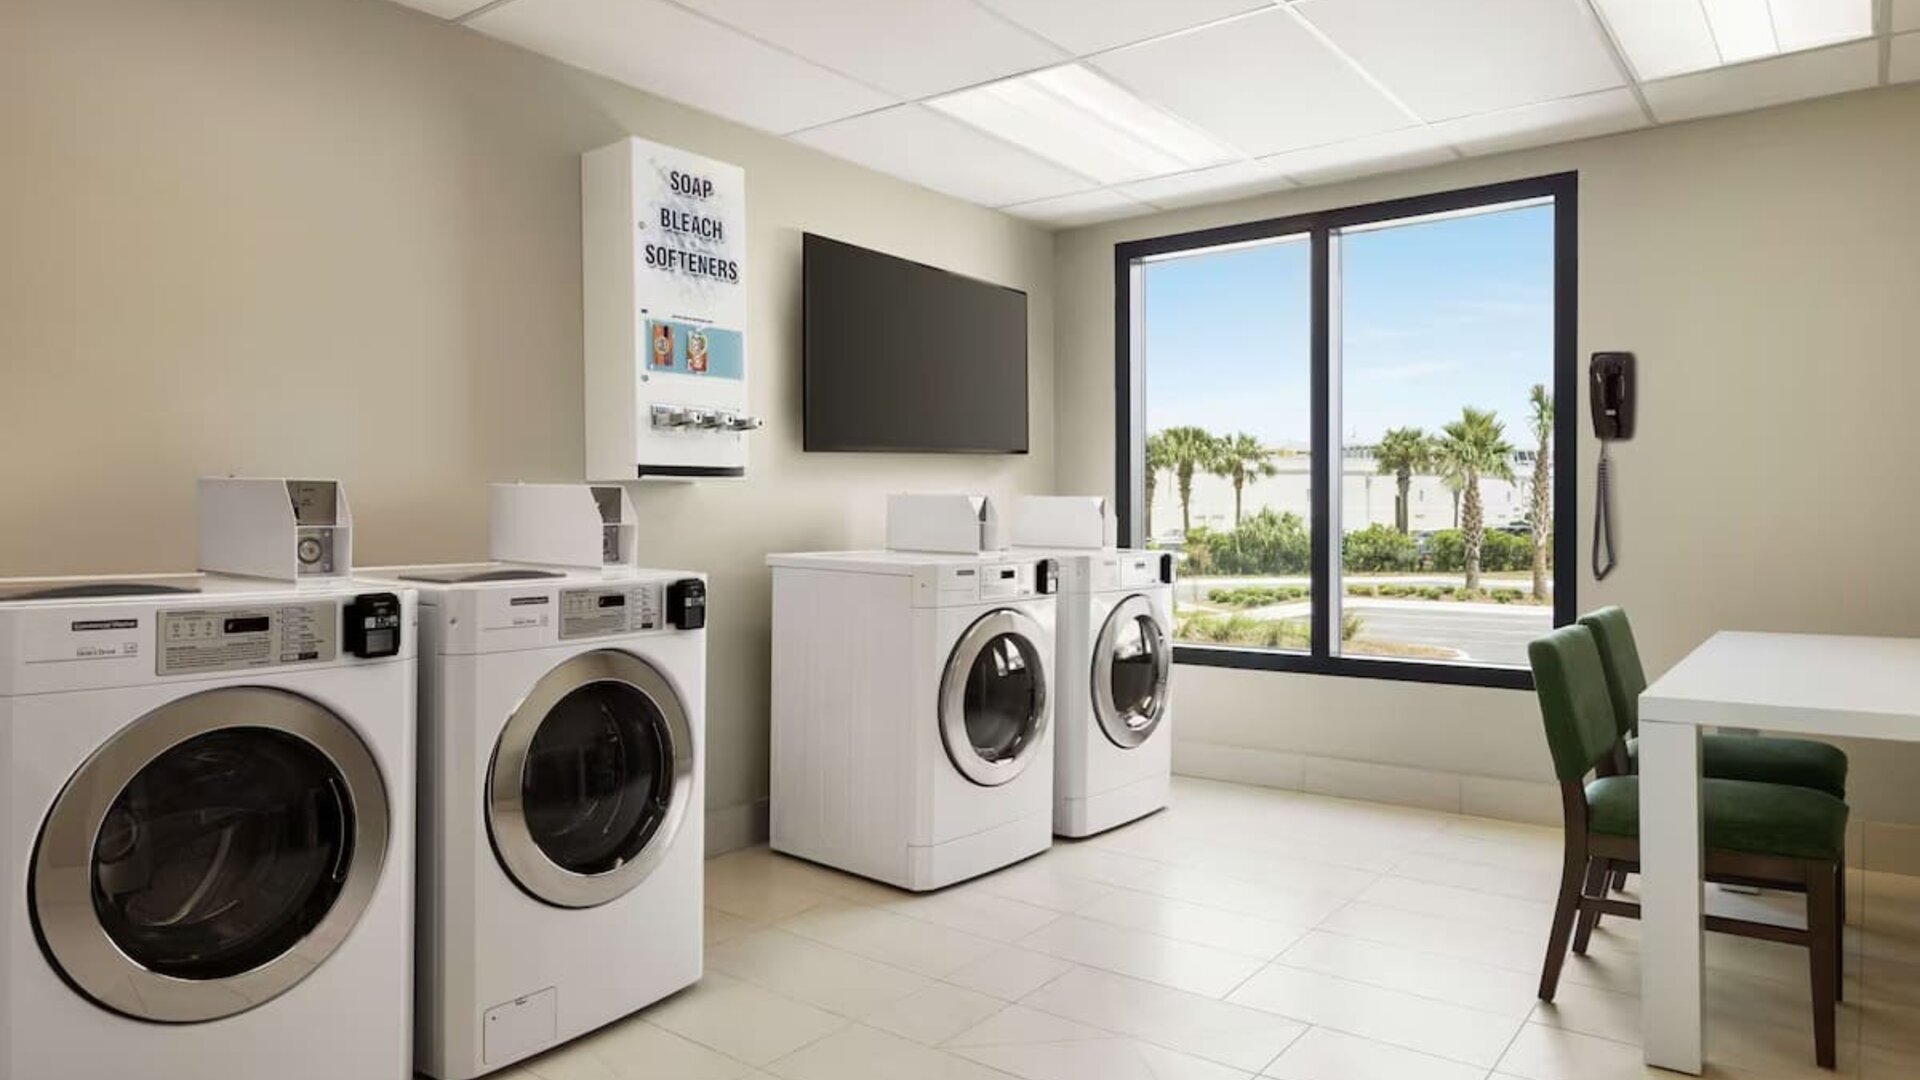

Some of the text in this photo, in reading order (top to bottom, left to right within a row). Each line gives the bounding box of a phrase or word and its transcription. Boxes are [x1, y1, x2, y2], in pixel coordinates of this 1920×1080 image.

[670, 170, 712, 198] SOAP
[660, 207, 722, 239] BLEACH
[645, 244, 738, 280] SOFTENERS
